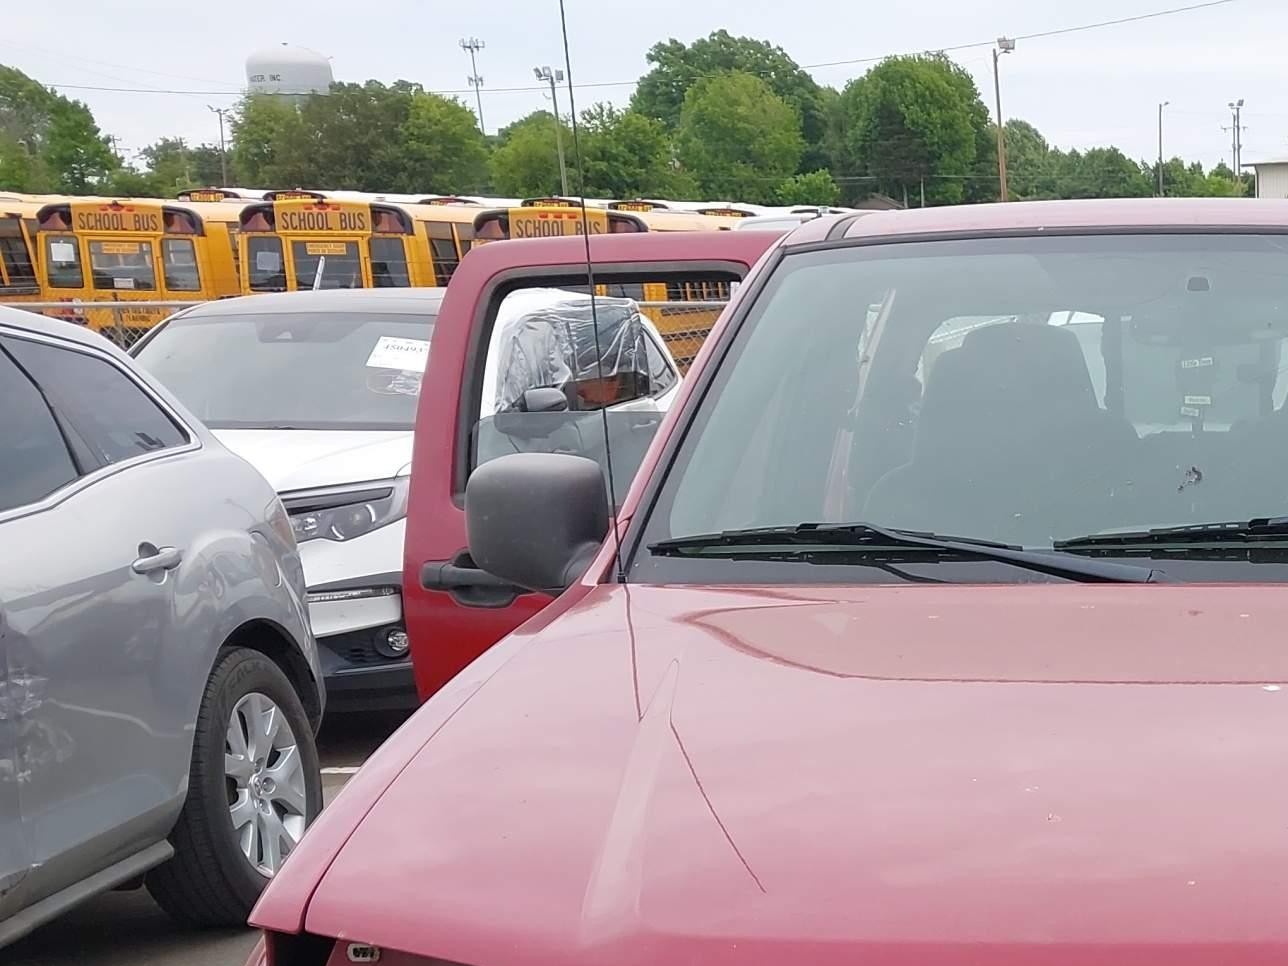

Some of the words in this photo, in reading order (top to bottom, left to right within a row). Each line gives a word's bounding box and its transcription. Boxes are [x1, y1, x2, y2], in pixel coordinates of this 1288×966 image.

[78, 212, 127, 231] SCHOOL
[134, 213, 158, 231] BUS
[281, 211, 333, 231] SCHOOL
[339, 212, 366, 231] BUS
